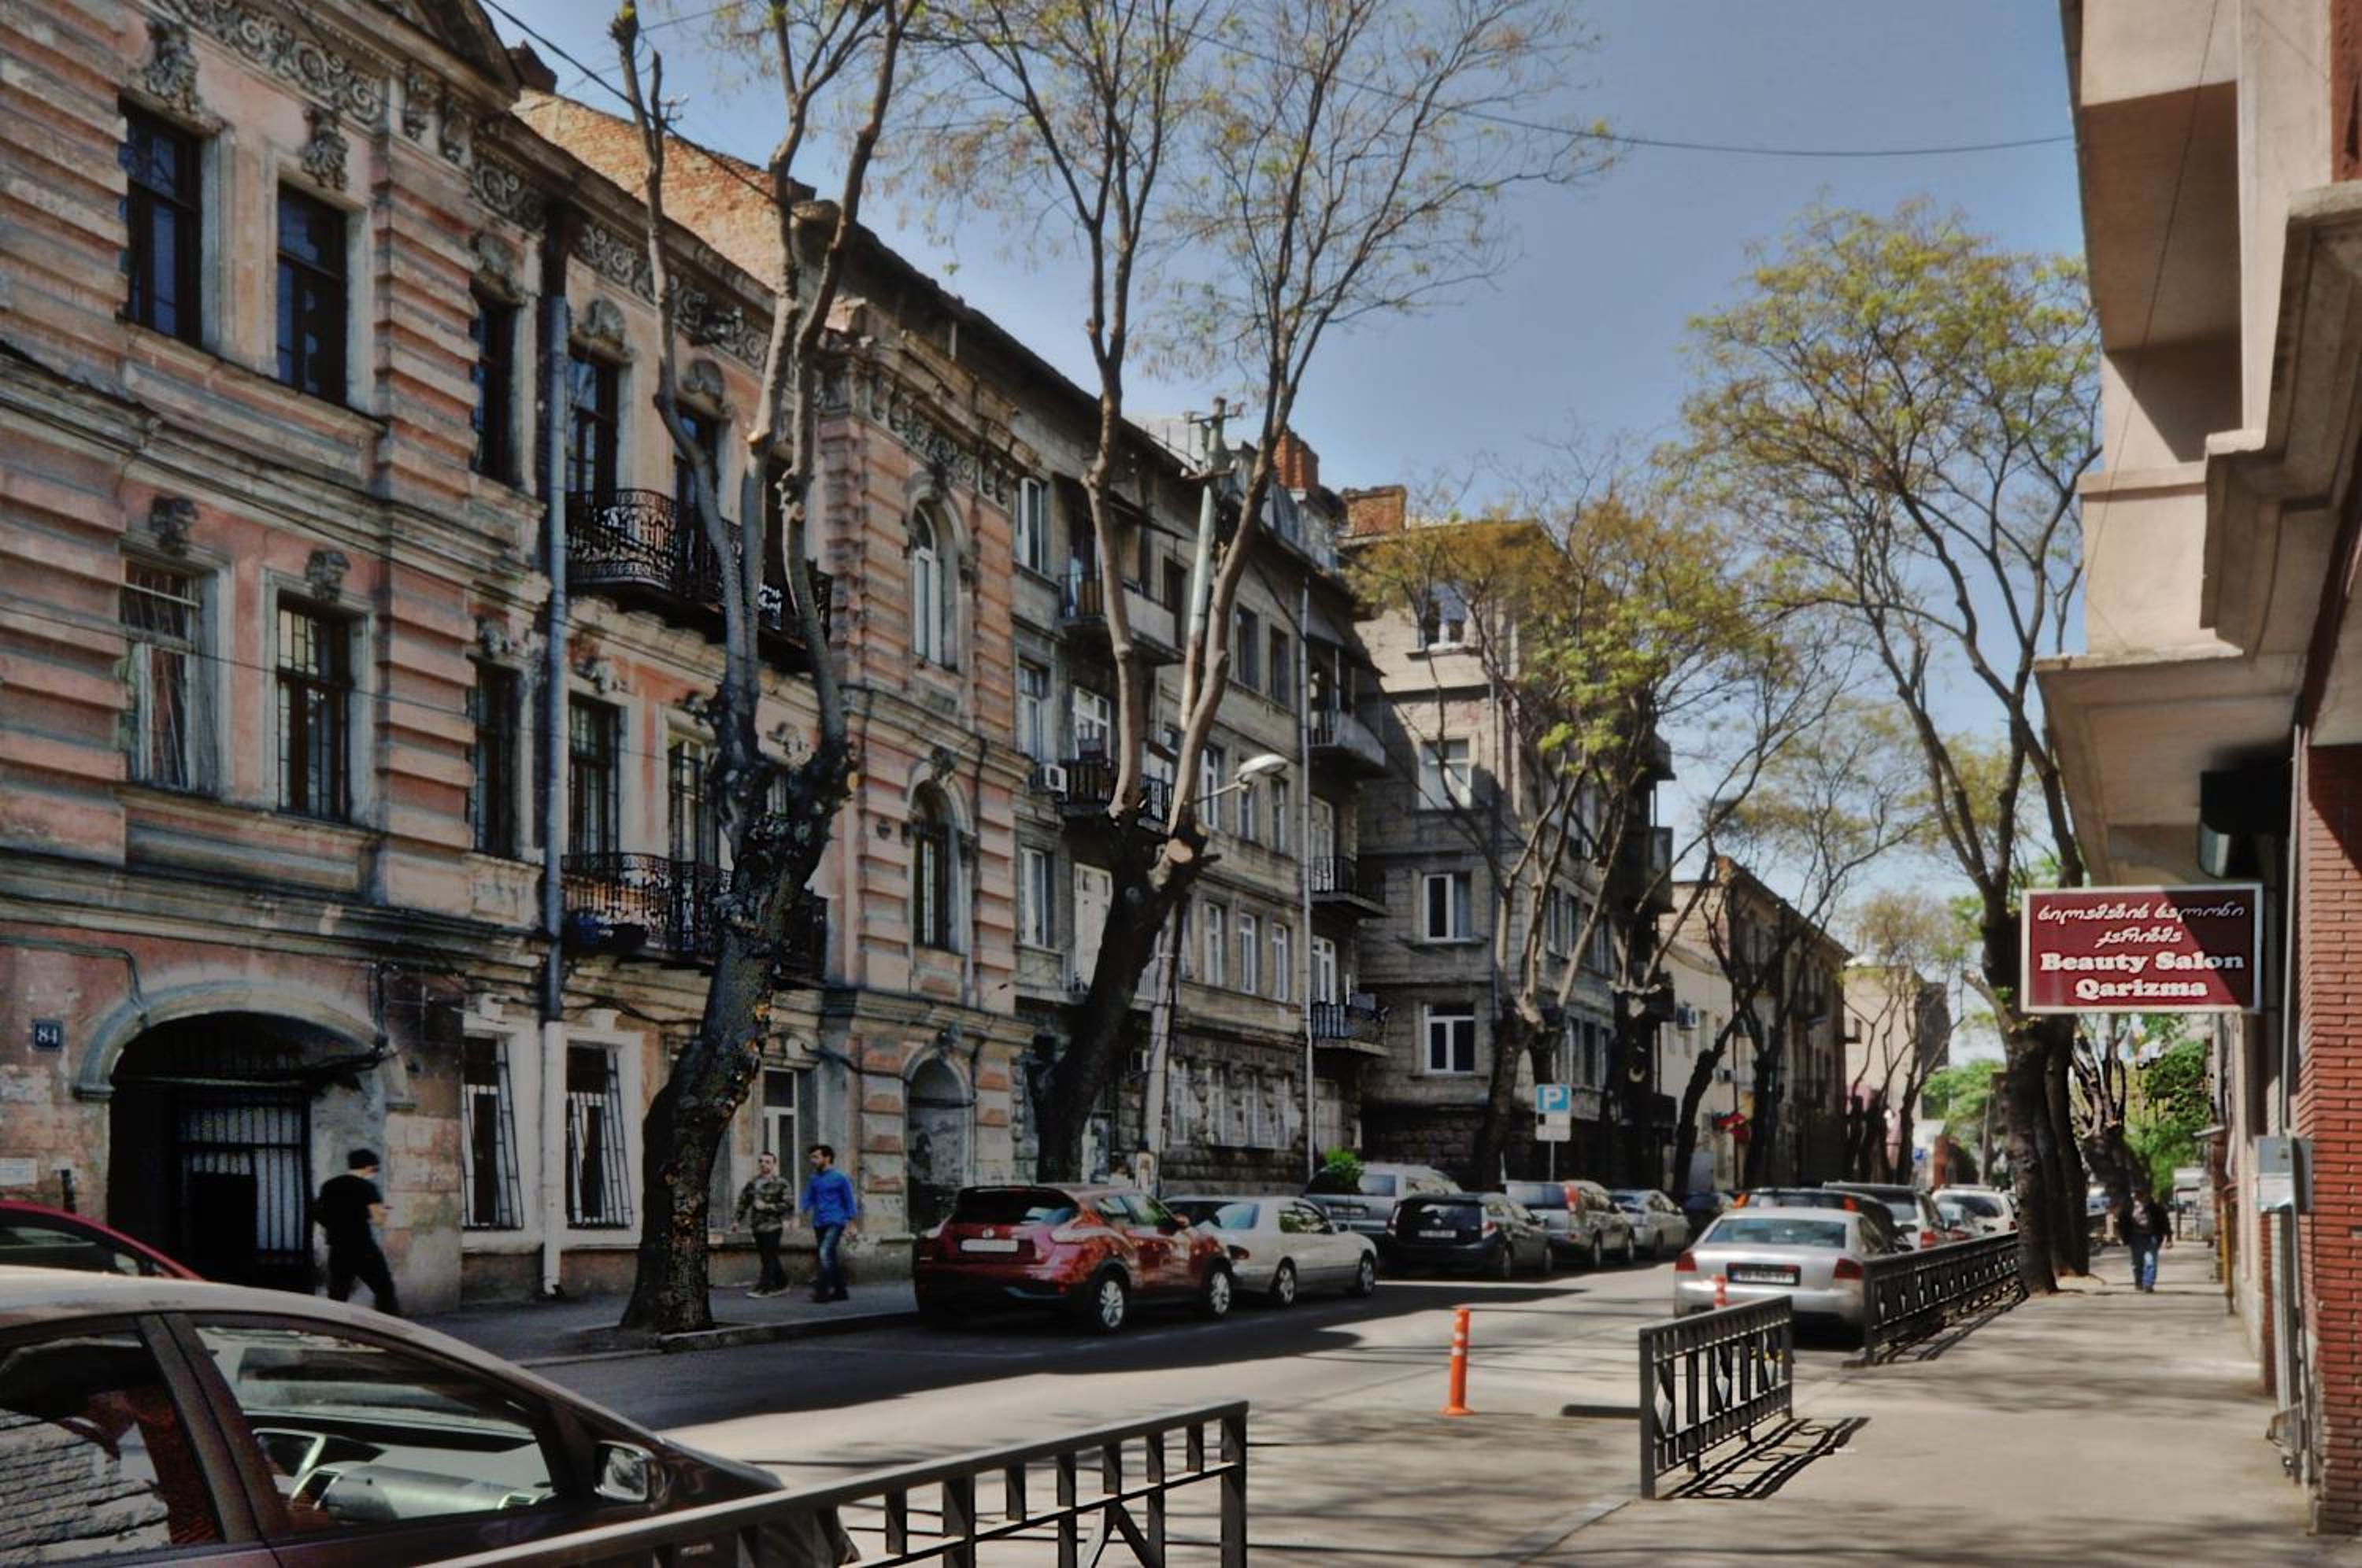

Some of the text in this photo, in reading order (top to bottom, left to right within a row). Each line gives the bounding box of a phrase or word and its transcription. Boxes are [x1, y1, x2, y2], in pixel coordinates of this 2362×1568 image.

[2038, 901, 2245, 925] სილამაზის სალონი
[2094, 926, 2183, 949] ქარიზმა
[2040, 951, 2244, 974] Beauty Salon
[2075, 978, 2208, 1000] Qarizma
[1544, 1086, 1563, 1109] P
